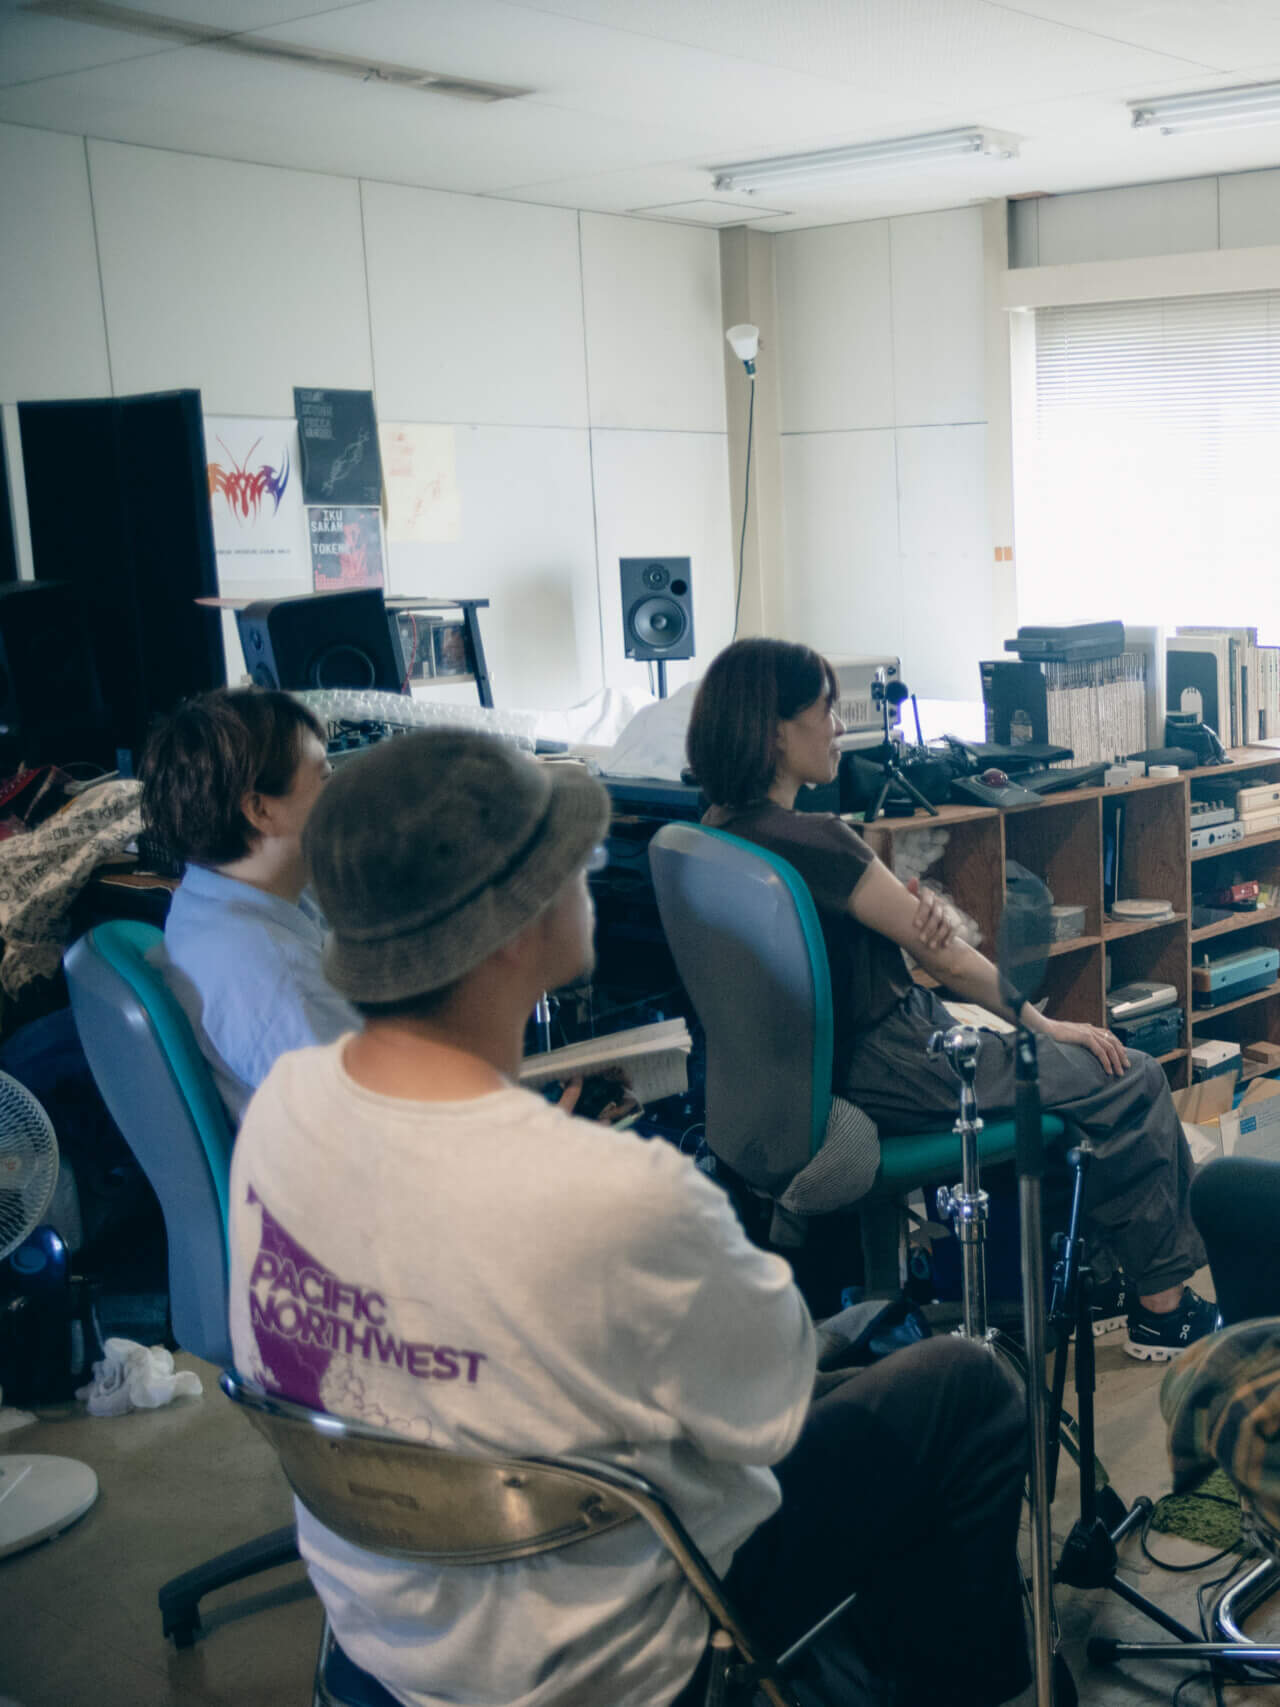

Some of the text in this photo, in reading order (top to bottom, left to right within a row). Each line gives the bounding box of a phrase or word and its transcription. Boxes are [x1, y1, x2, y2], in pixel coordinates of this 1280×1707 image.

[322, 509, 343, 521] IKU
[250, 1250, 387, 1326] PACIFIC
[249, 1287, 488, 1383] NORTHWEST
